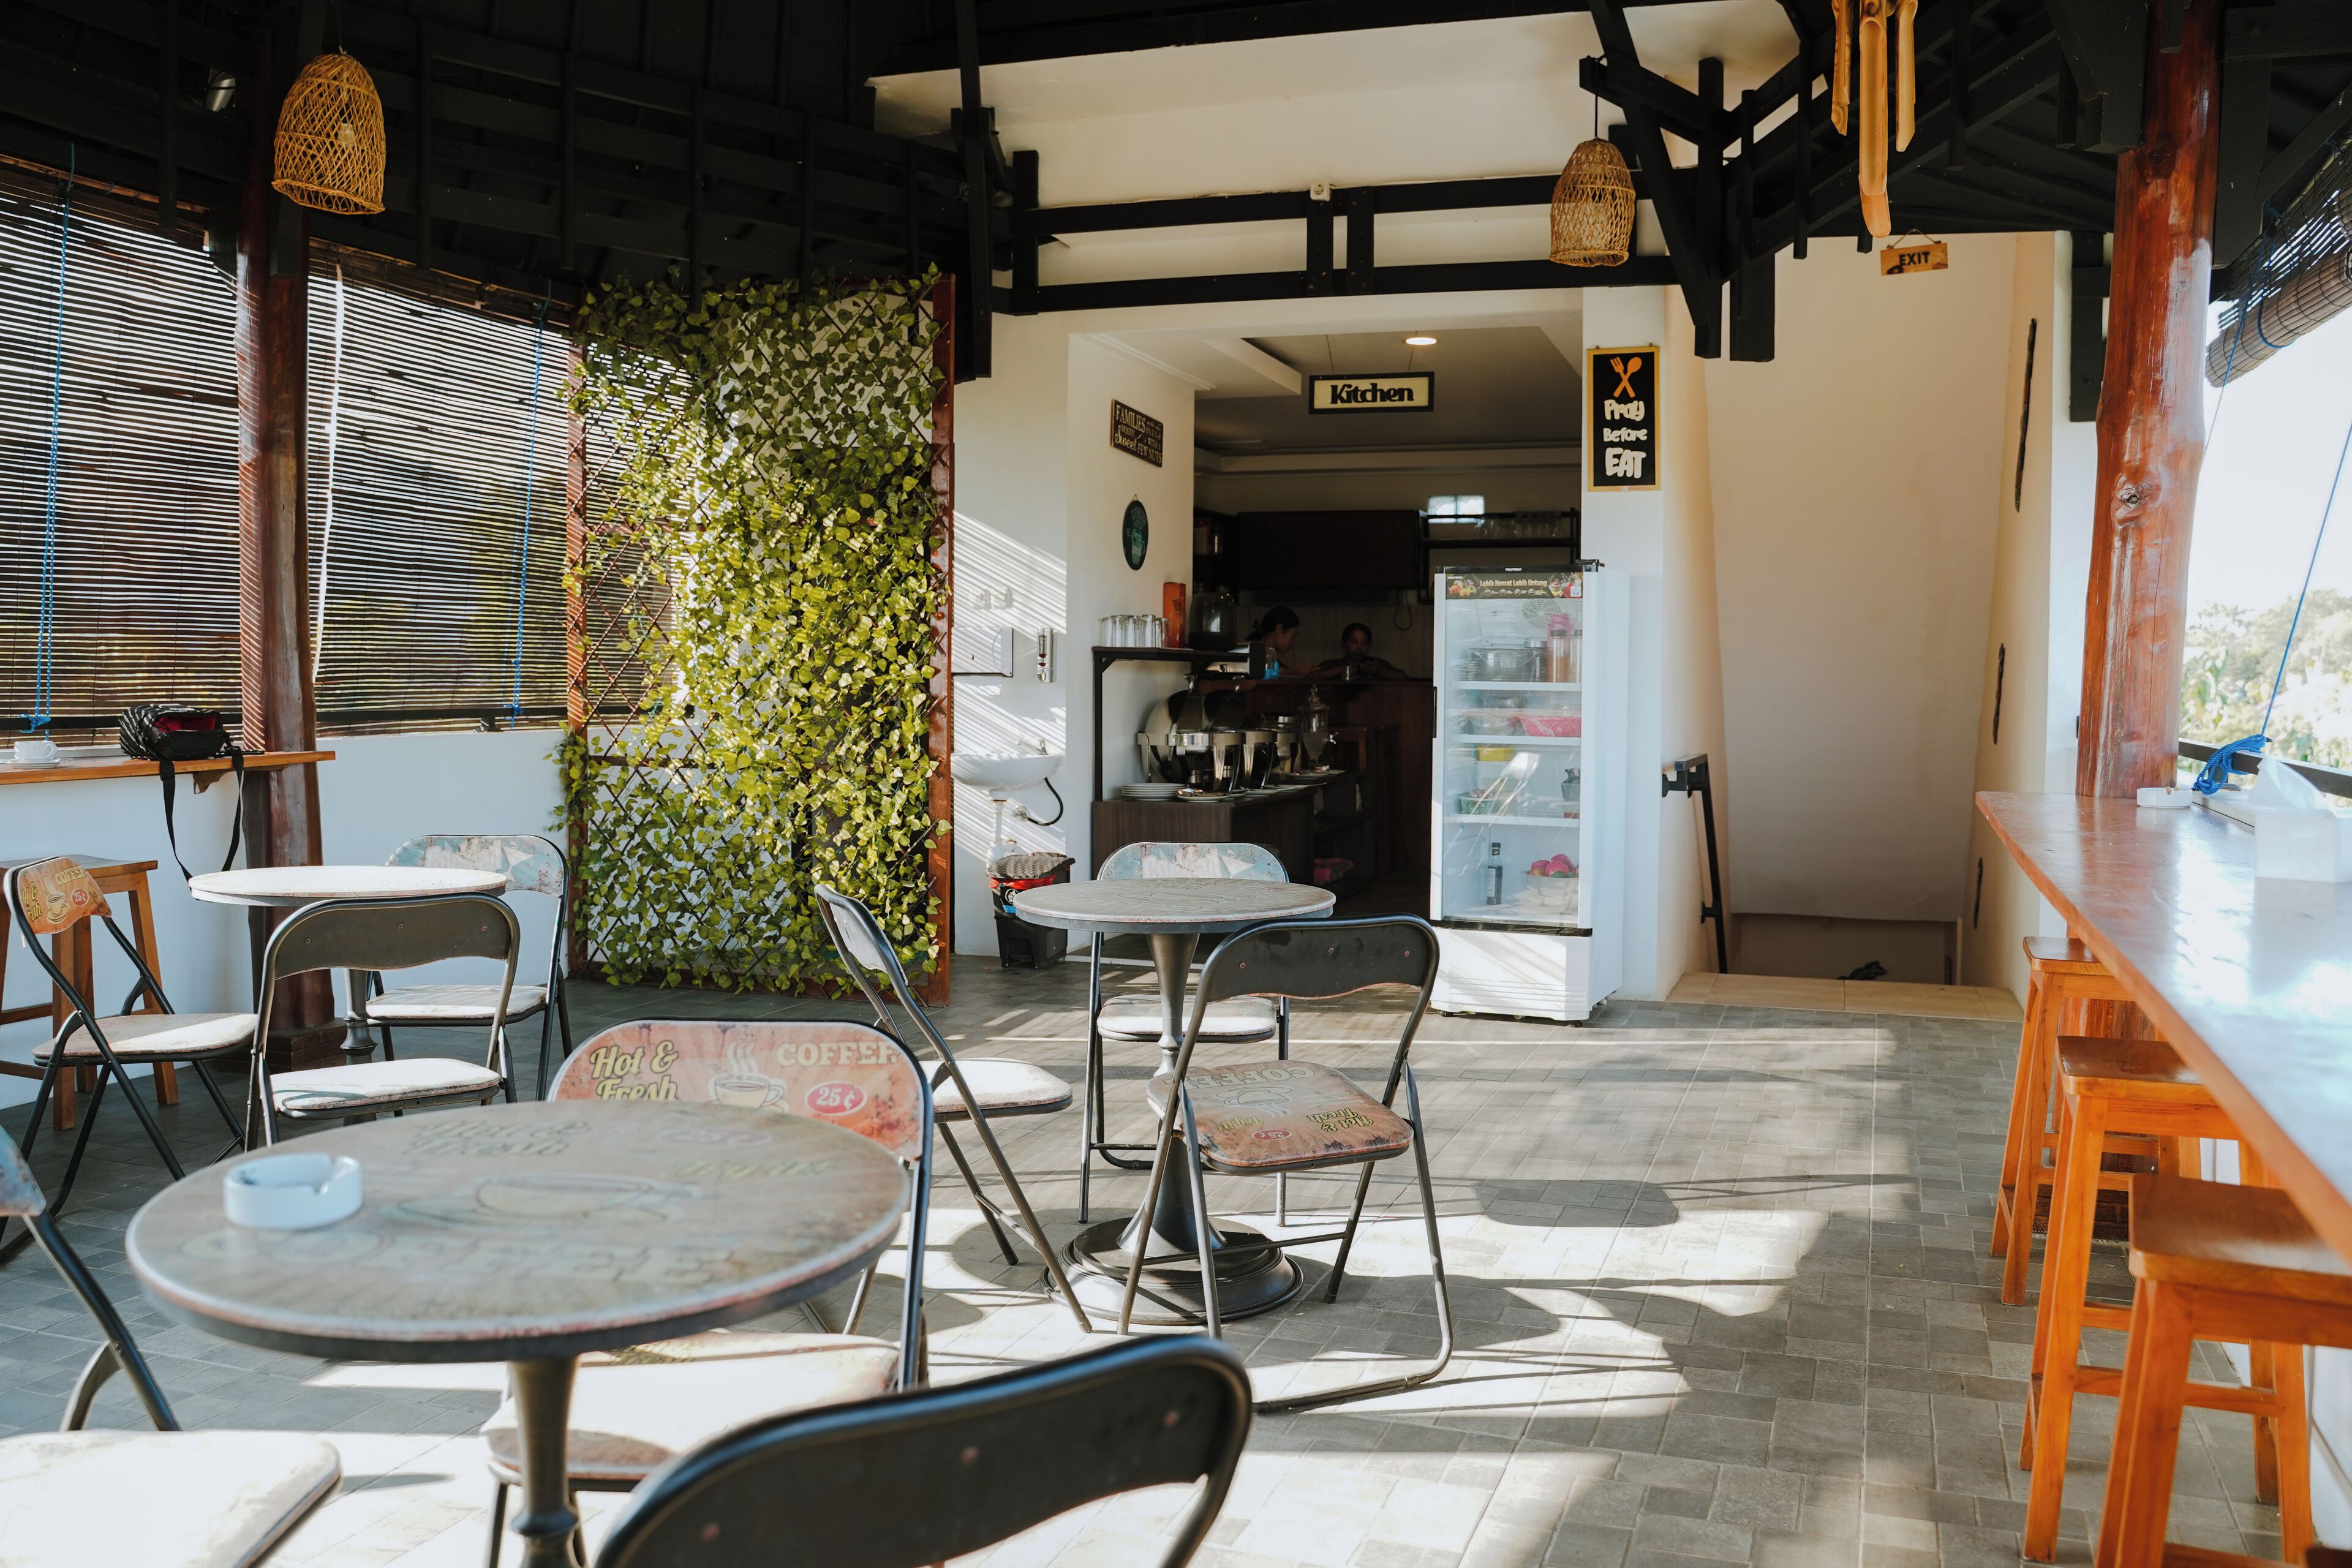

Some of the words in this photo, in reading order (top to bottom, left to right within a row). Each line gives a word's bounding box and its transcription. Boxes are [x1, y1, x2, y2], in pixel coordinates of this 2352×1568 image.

[1899, 251, 1930, 266] EXIT
[1330, 383, 1414, 404] Kitchen
[1604, 399, 1645, 421] Pray
[1116, 404, 1146, 433] FAMILIES
[1115, 425, 1137, 451] Sweet
[1603, 427, 1648, 442] Before
[1148, 448, 1162, 464] NUTS
[1605, 447, 1646, 479] EAT
[74, 892, 81, 902] 25
[589, 1042, 645, 1080] Hot
[650, 1040, 679, 1074] &
[816, 1085, 841, 1107] 25
[1306, 1107, 1359, 1121] Fresh
[1343, 1115, 1374, 1129] Hot
[1270, 1131, 1284, 1139] 25
[1321, 1121, 1339, 1133] &
